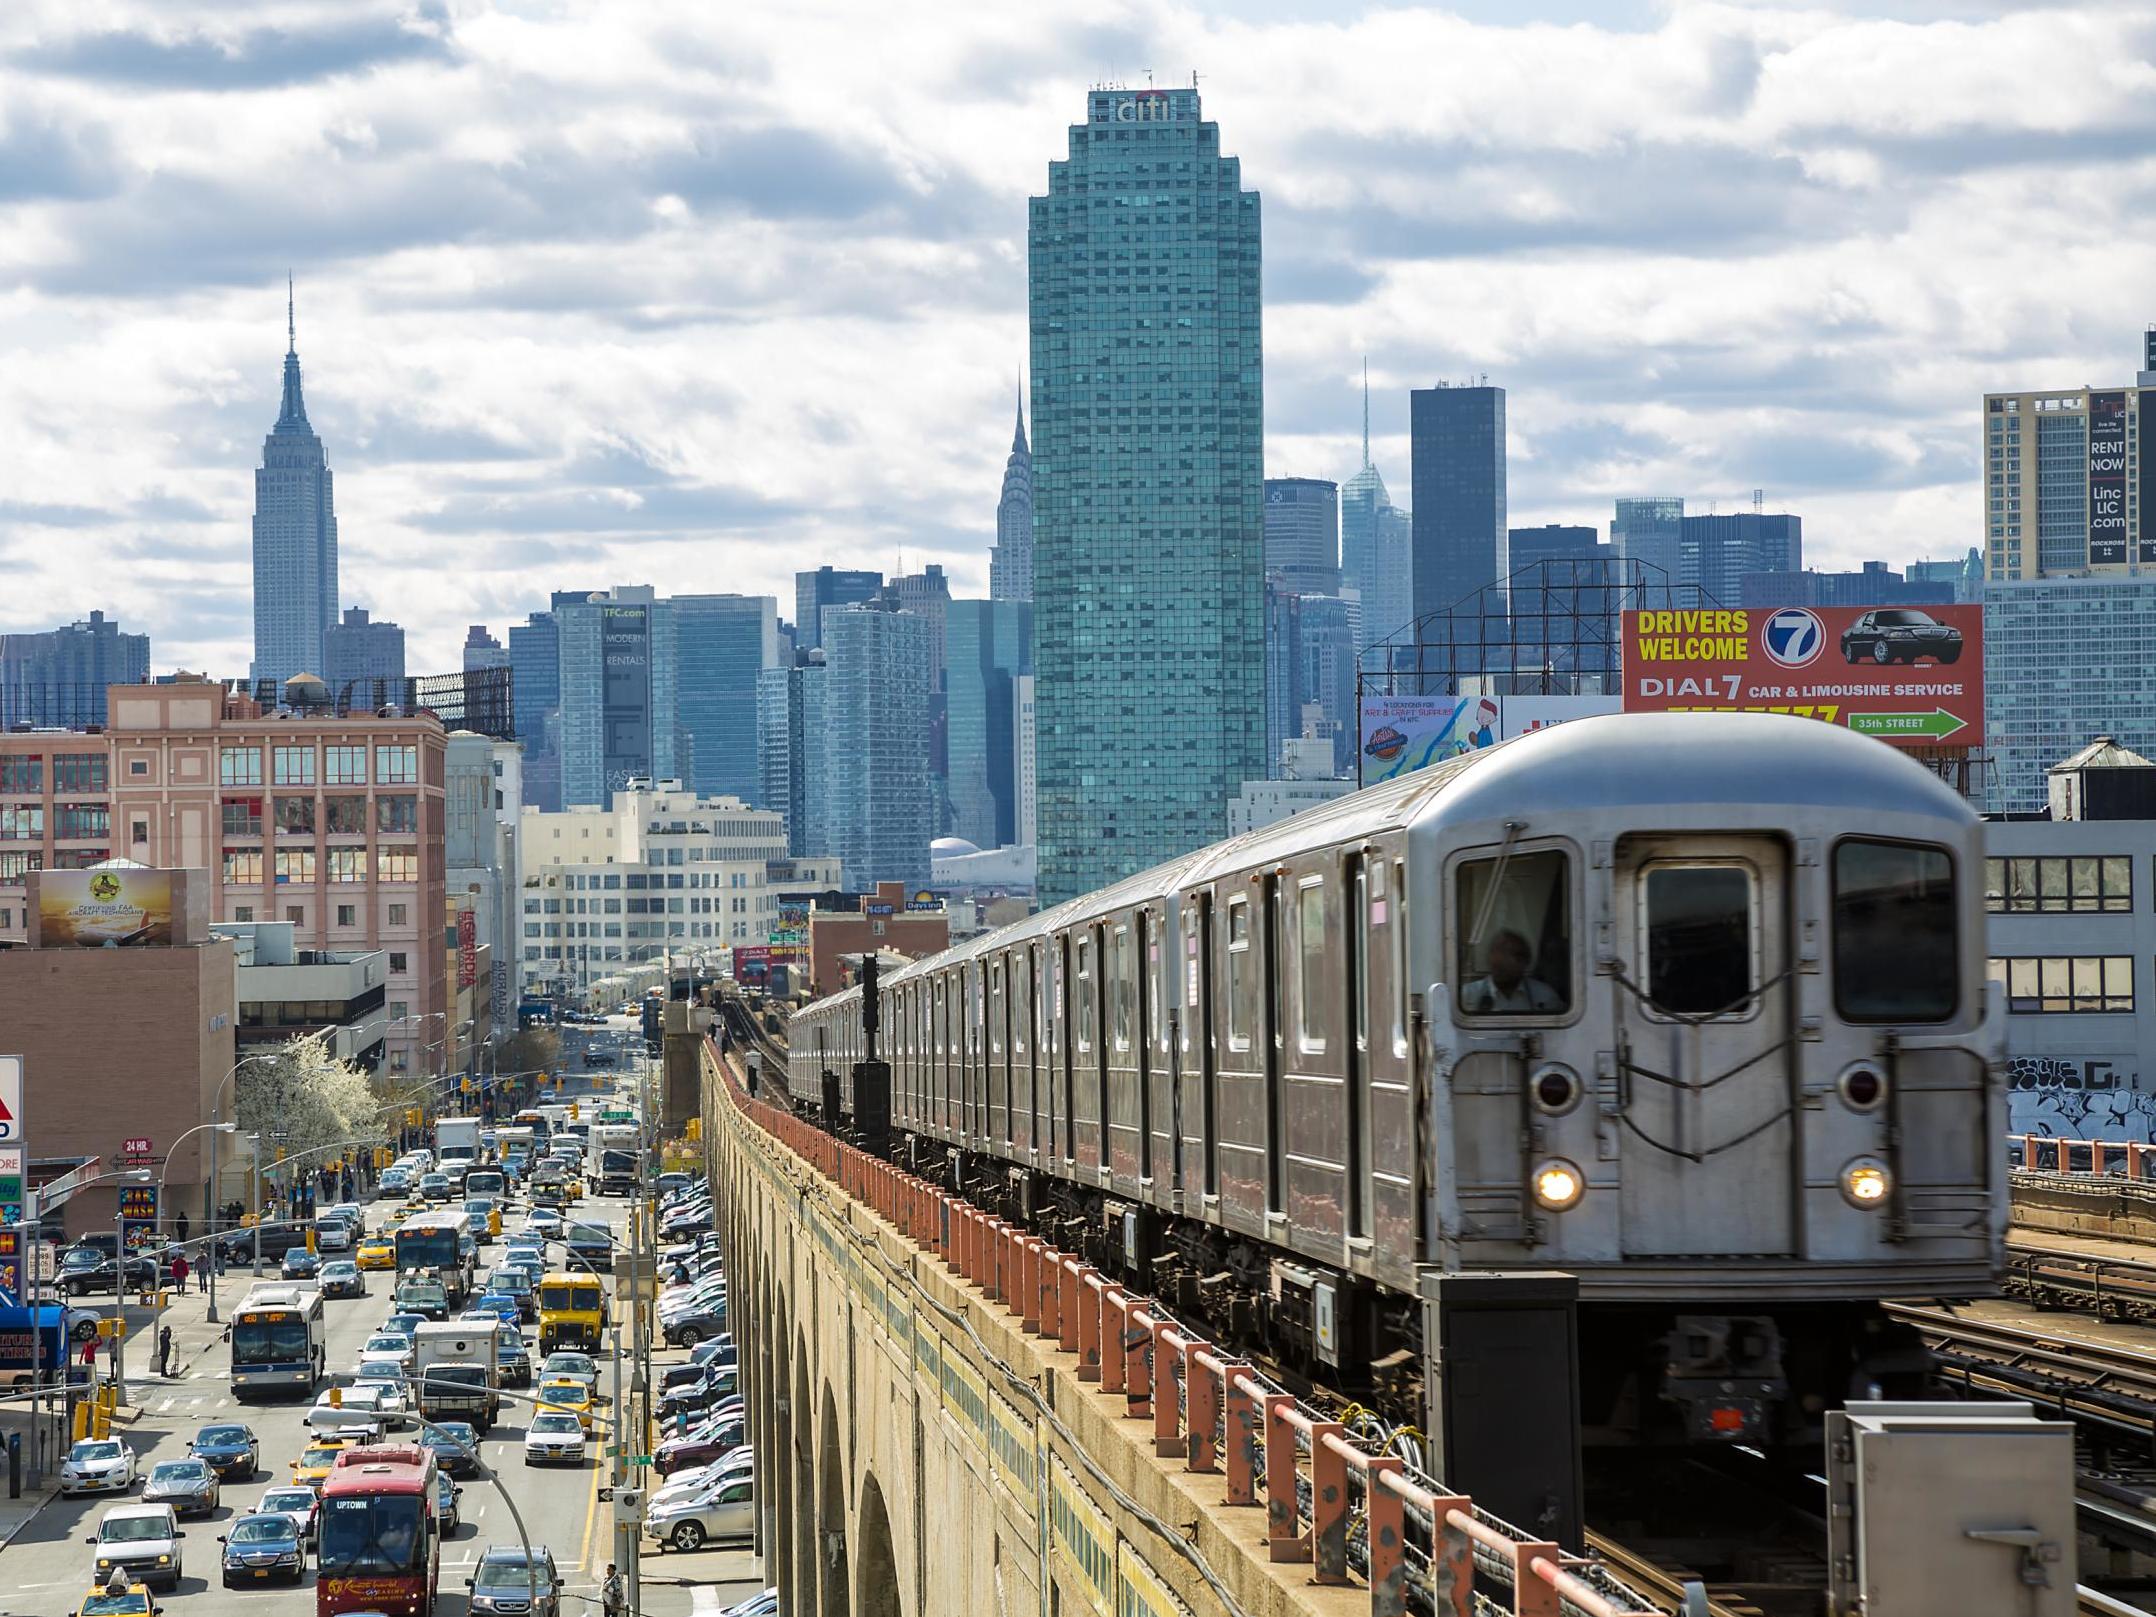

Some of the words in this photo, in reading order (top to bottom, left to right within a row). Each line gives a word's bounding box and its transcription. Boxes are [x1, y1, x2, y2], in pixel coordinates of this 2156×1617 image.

[1117, 95, 1168, 122] citi
[2091, 441, 2124, 454] RENT
[2090, 458, 2125, 471] NOW
[2094, 487, 2121, 500] Linc
[2097, 501, 2119, 514] LIC
[2090, 517, 2125, 529] .com
[2091, 539, 2125, 547] ROCKROSE
[604, 608, 645, 618] TFC.com
[1638, 610, 1749, 634] DRIVERS
[606, 634, 646, 643] MODERN
[1774, 616, 1812, 659] 7
[1638, 637, 1749, 661] WELCOME
[606, 656, 646, 665] RENTALS
[1749, 686, 1781, 698] CAR
[1785, 686, 1798, 698] &
[1802, 684, 1891, 697] LIMOUSINE
[1894, 683, 1963, 696] SERVICE
[1365, 709, 1382, 717] ART
[1391, 709, 1415, 717] CRAFT
[1858, 719, 1882, 728] 35th
[1886, 719, 1924, 728] STREET
[126, 1141, 135, 1151] 24
[123, 1204, 154, 1217] WASH
[336, 1501, 367, 1509] UPTOWN
